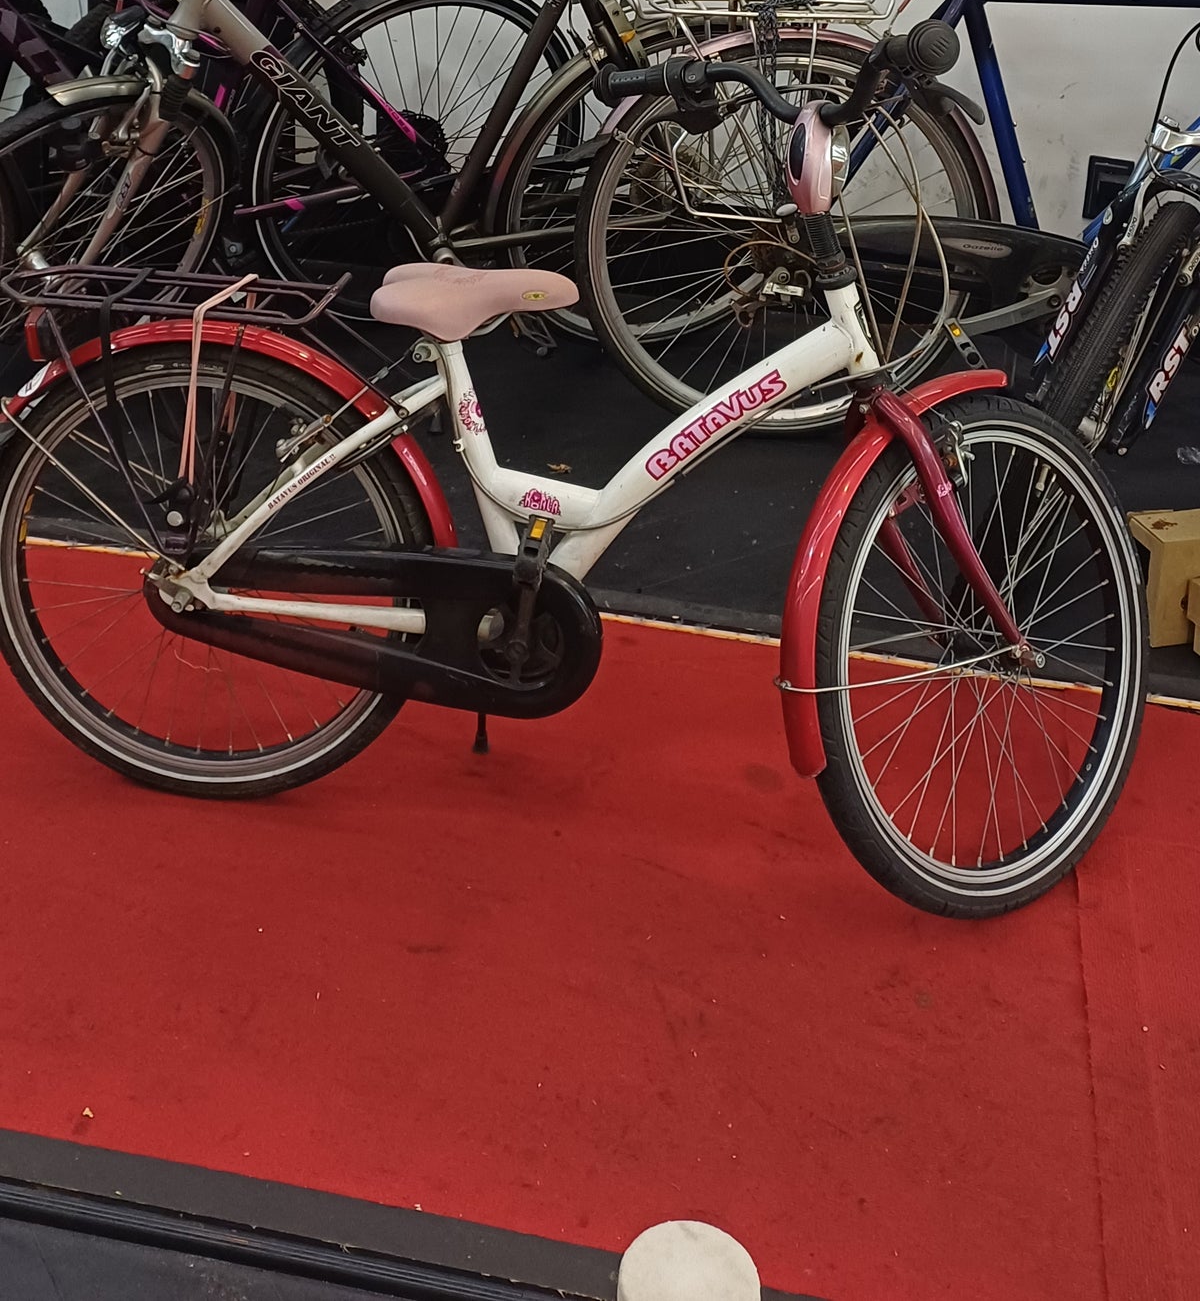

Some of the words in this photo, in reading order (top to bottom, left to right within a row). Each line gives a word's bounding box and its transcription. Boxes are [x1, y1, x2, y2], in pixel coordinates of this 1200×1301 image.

[251, 50, 361, 148] GIANT
[962, 243, 1004, 252] Gazelle
[1047, 280, 1086, 358] RST
[1148, 324, 1190, 404] RST
[645, 369, 787, 481] BATAVUS
[267, 483, 298, 510] BATAVUS
[297, 458, 330, 486] ORIGINAL
